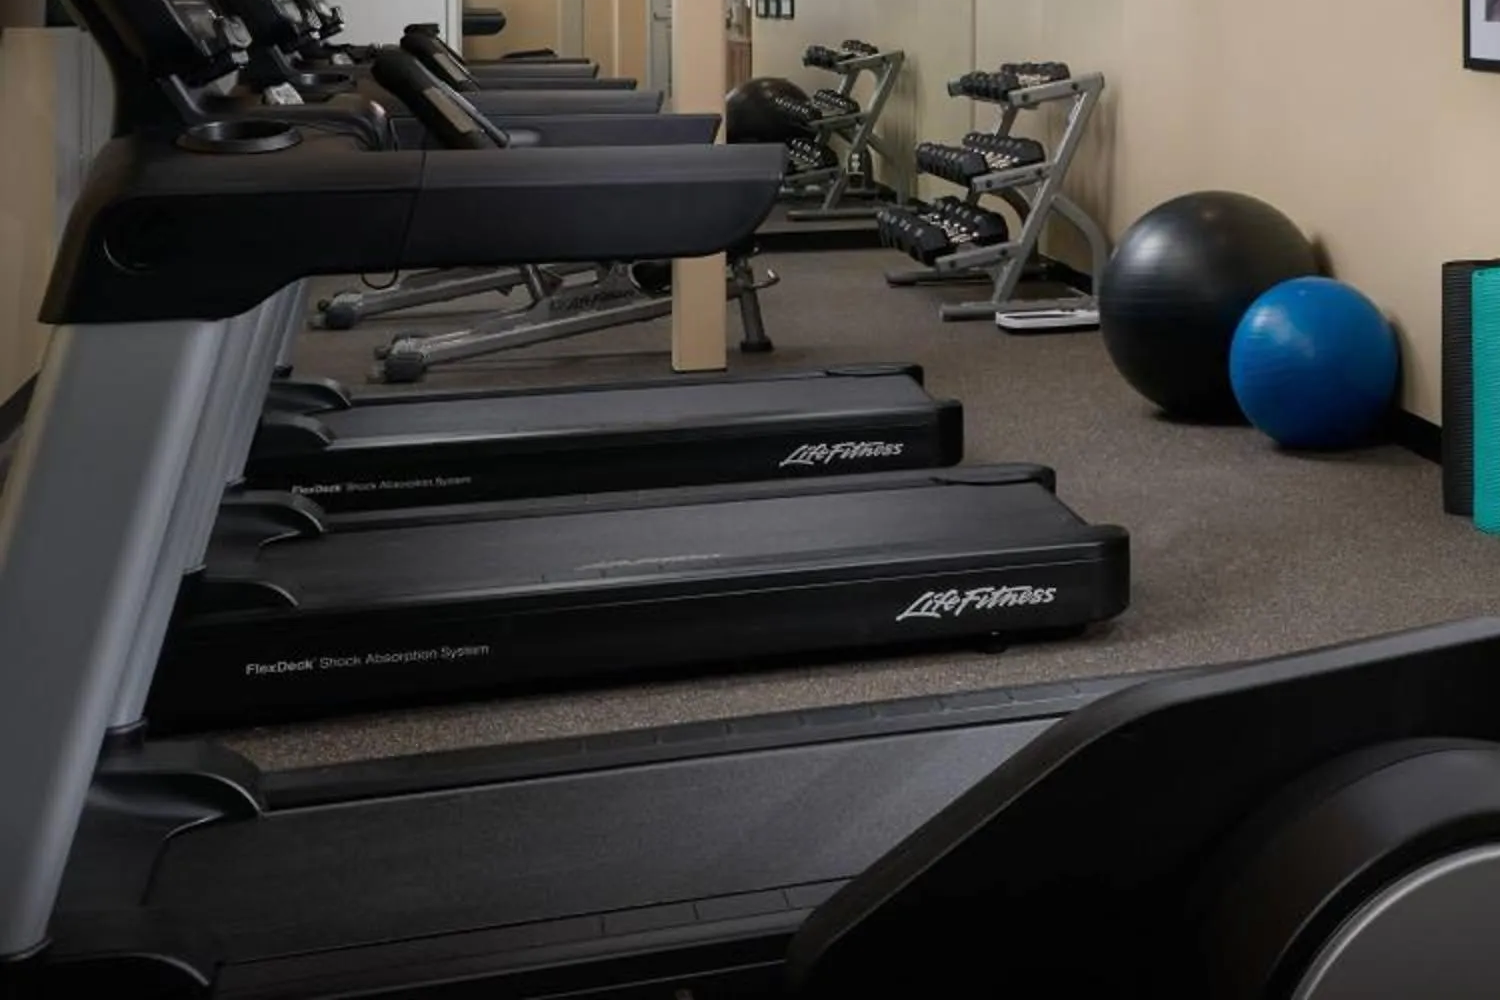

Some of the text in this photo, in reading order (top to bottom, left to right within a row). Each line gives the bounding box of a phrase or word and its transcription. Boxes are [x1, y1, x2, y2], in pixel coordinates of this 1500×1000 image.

[319, 656, 361, 669] Shock
[365, 648, 438, 664] Absorption
[440, 645, 489, 659] System
